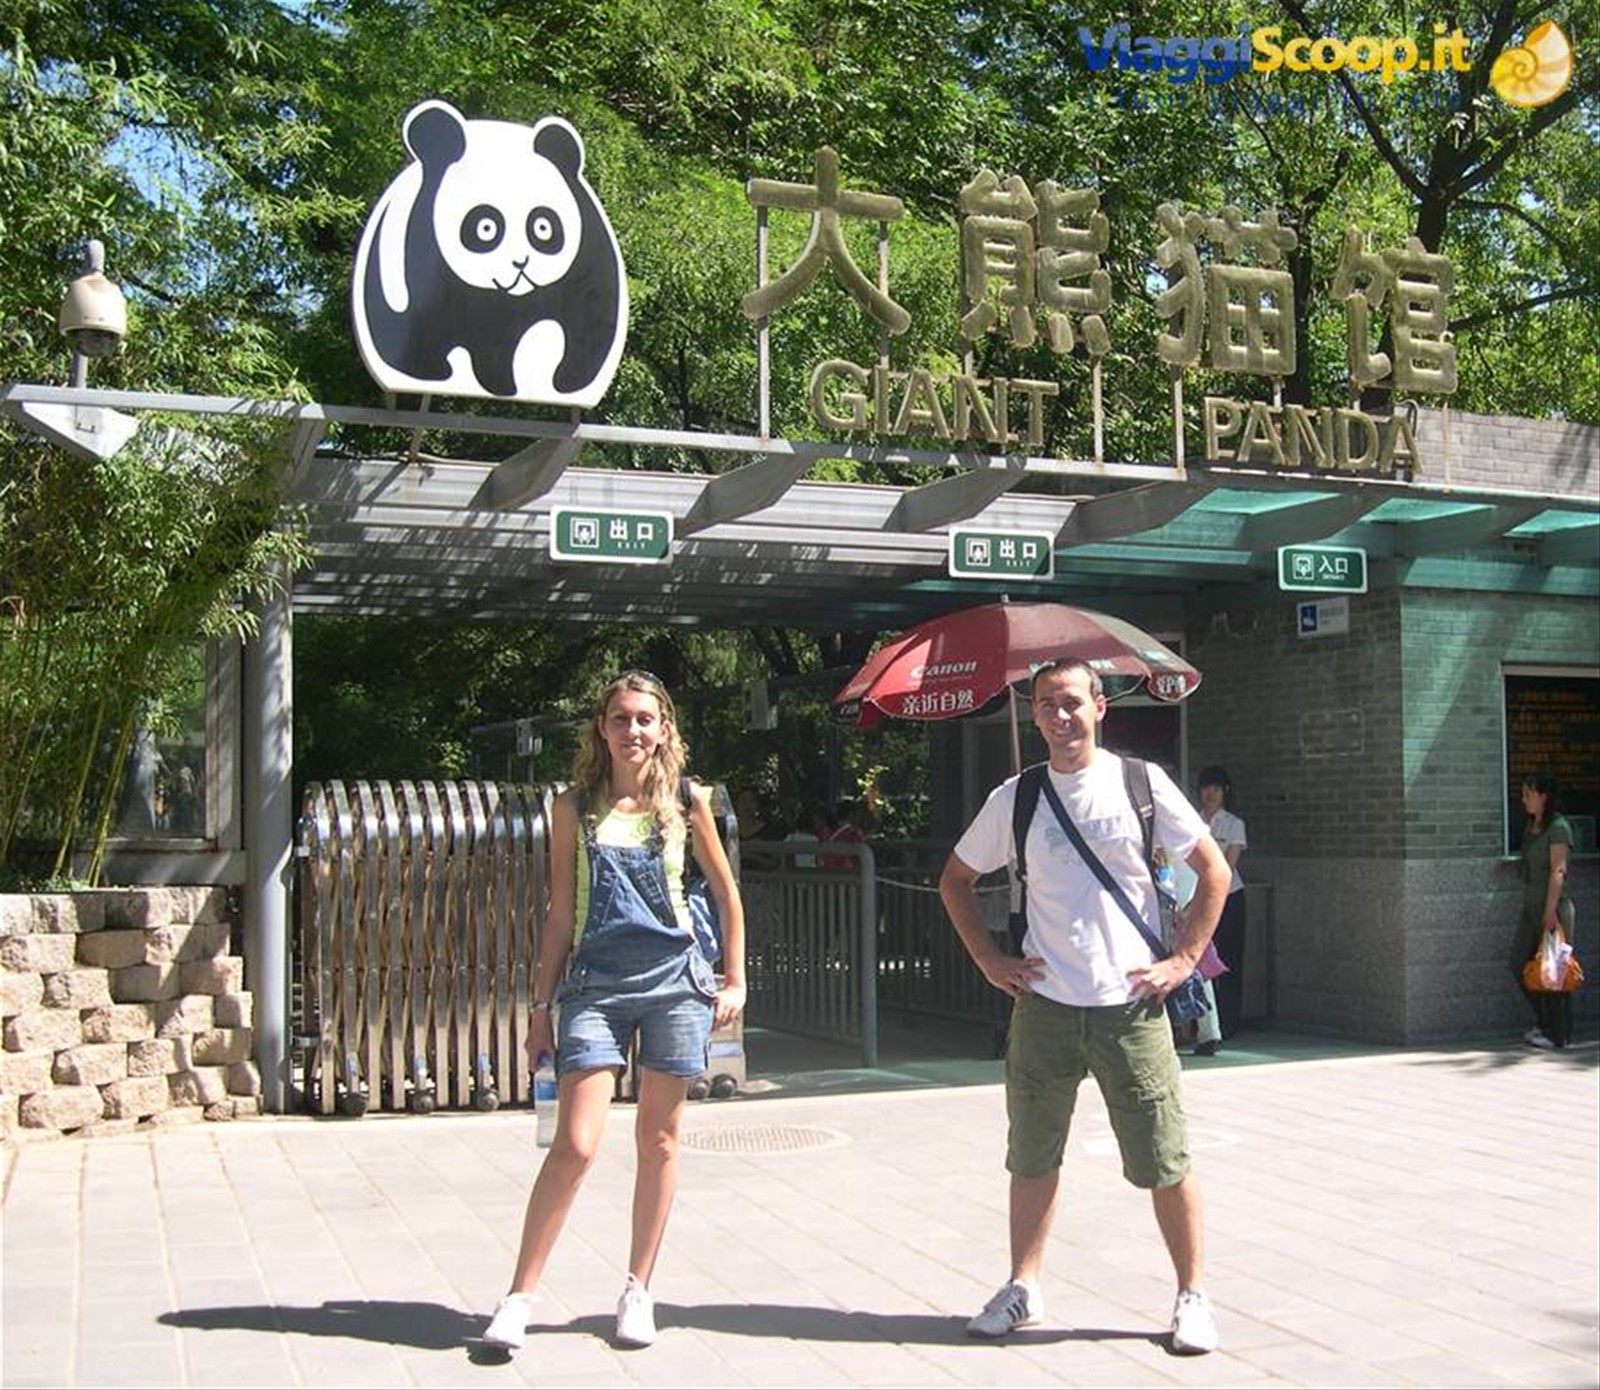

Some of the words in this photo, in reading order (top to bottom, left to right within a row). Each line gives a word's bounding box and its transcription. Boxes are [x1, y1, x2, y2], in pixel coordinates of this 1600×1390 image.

[741, 145, 1459, 395] 大熊猫馆
[811, 359, 1060, 448] GIANT
[1204, 396, 1424, 474] PANDA
[609, 517, 654, 541] 出口
[999, 538, 1037, 560] 出口
[1318, 554, 1349, 574] 入口
[910, 660, 978, 679] Canon
[902, 688, 975, 715] 亲近自然
